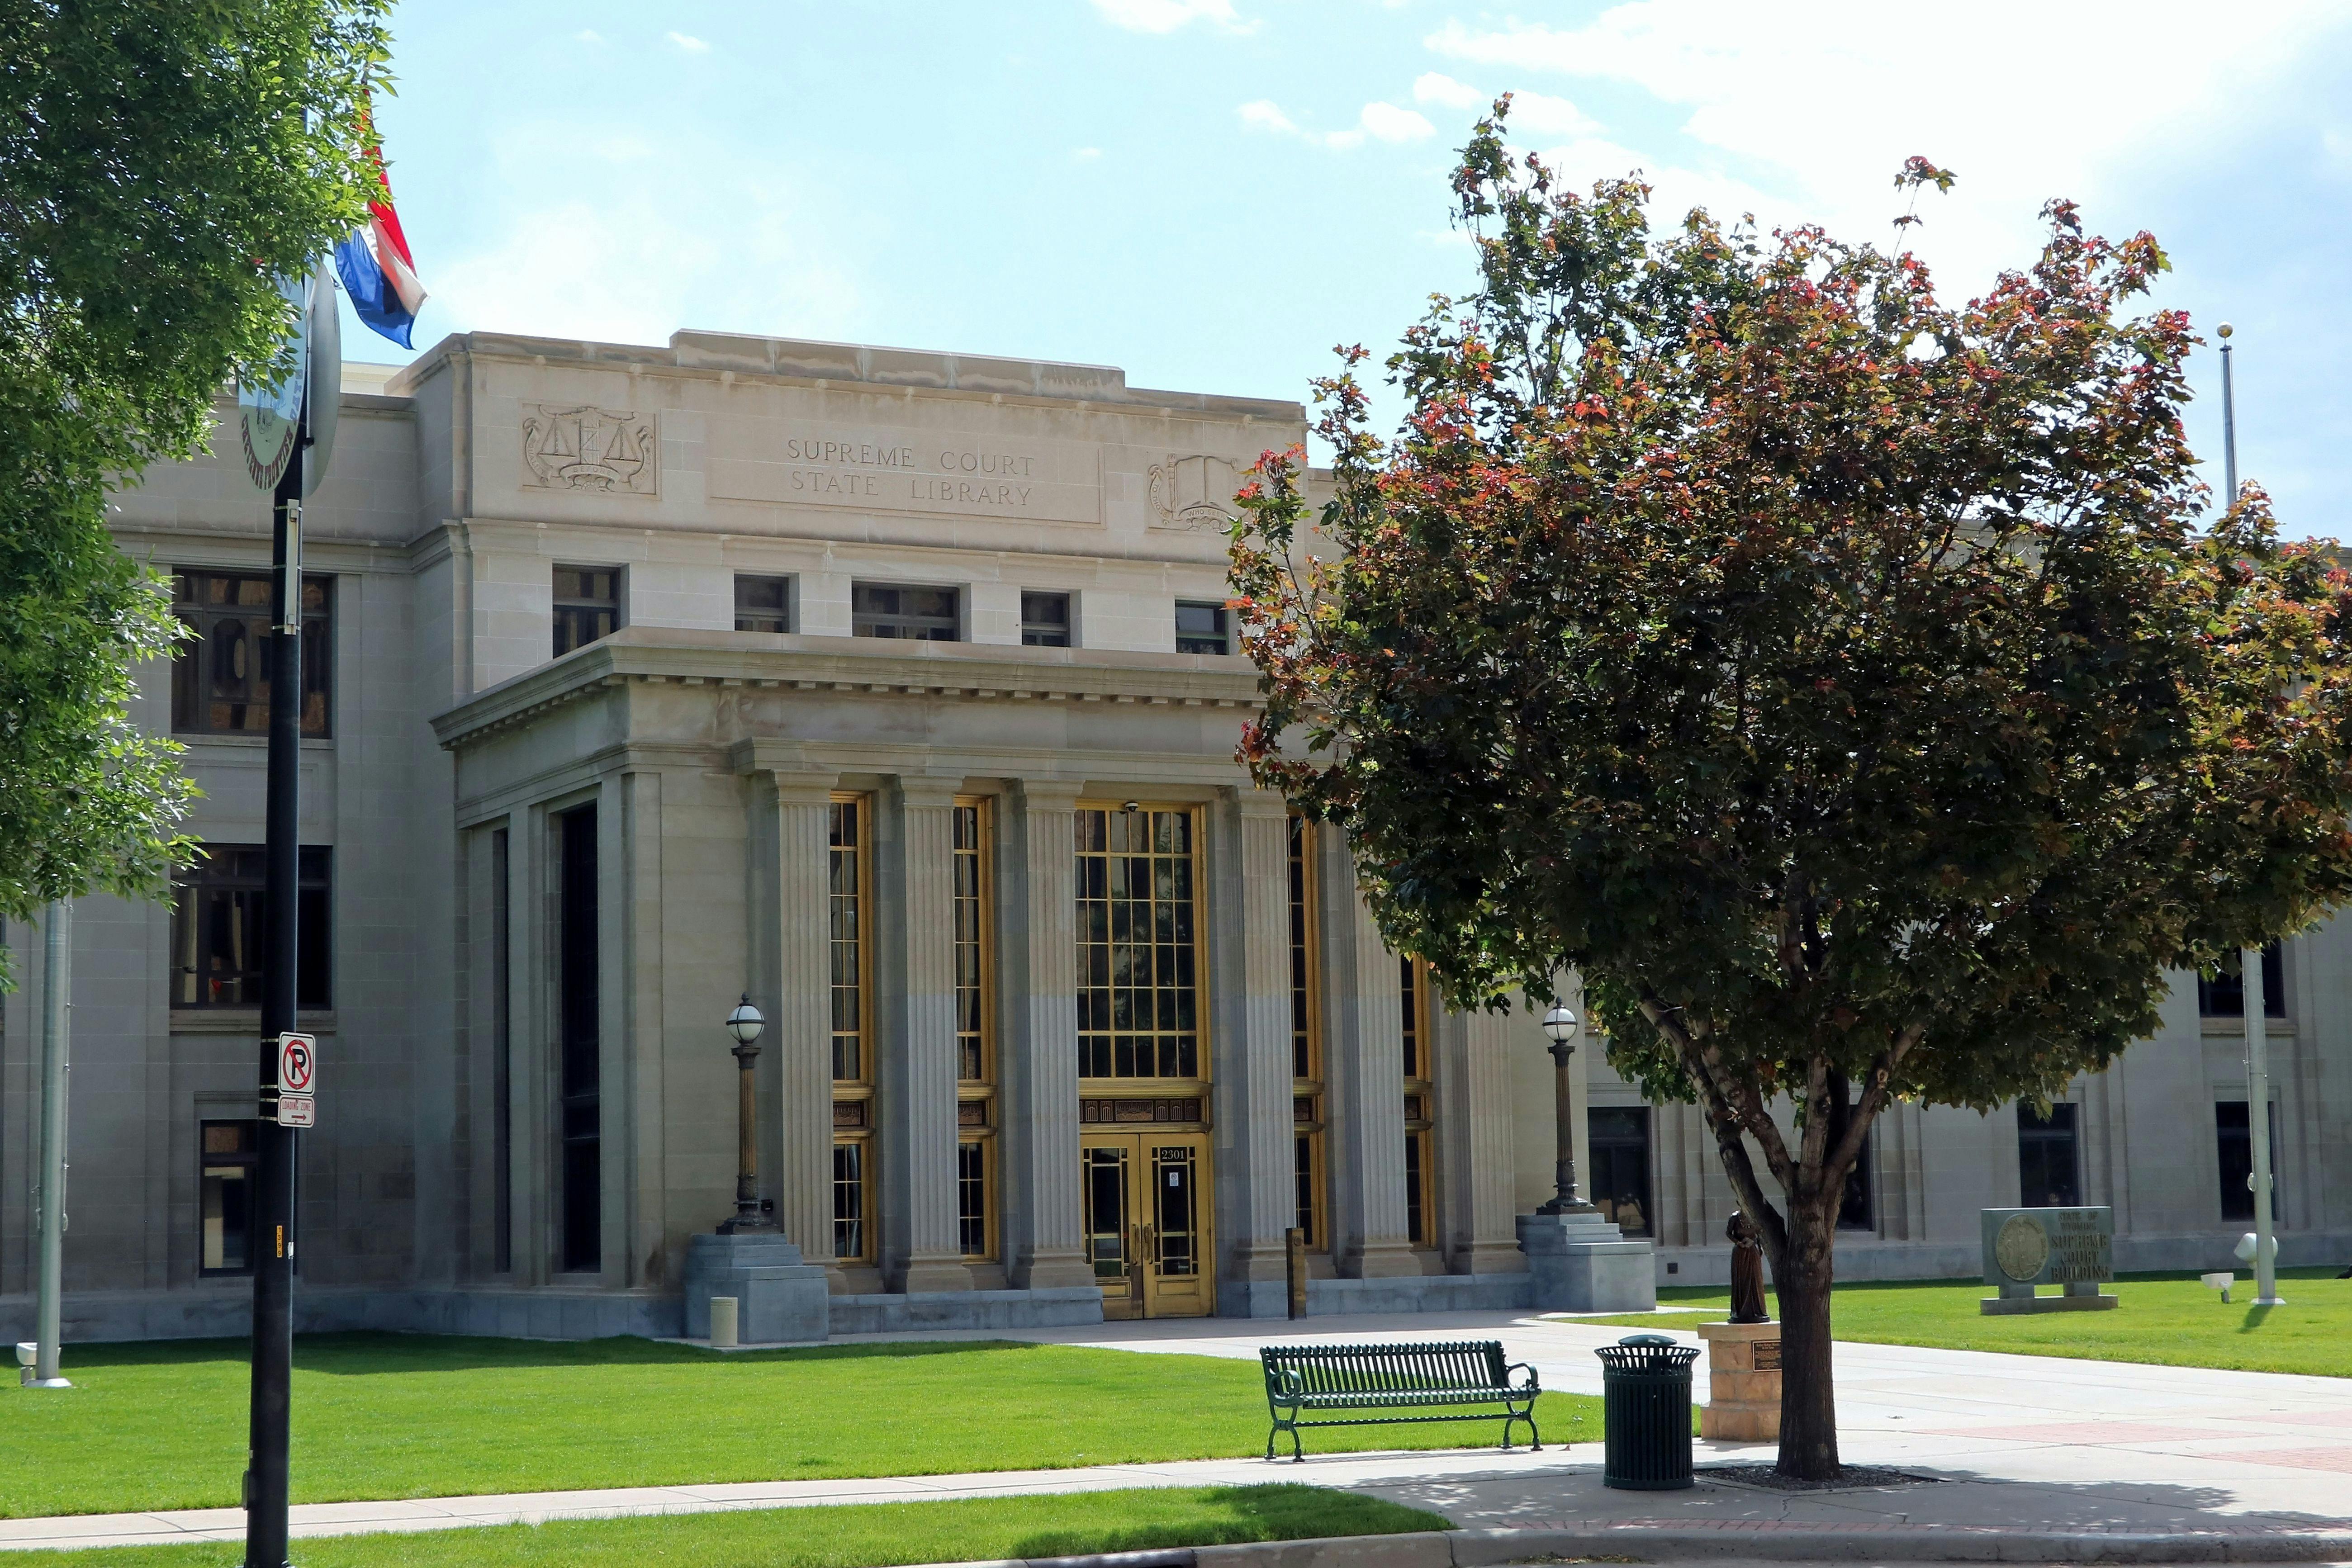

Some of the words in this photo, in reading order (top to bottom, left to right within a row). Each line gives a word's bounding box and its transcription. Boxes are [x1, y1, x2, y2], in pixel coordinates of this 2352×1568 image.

[241, 413, 264, 490] CHEYENNE
[265, 425, 293, 490] FRONTIER
[787, 439, 915, 467] SUPREME
[940, 451, 1035, 476] COURT
[573, 465, 612, 476] BEFORE
[791, 470, 879, 496] STATE
[911, 478, 1033, 506] LIBRARY
[1152, 483, 1160, 493] TO
[1152, 495, 1168, 518] THOSE
[1208, 509, 1226, 520] SEEK
[282, 1100, 299, 1111] LOADING
[300, 1102, 311, 1111] ZONE
[1161, 1150, 1185, 1160] 2301
[2058, 1212, 2081, 1221] STATE
[2088, 1211, 2098, 1221] OF
[2060, 1222, 2097, 1231] WYOMING
[2051, 1233, 2107, 1249] SUPREME
[2060, 1250, 2099, 1264] COURT
[2050, 1265, 2109, 1281] BUILDING
